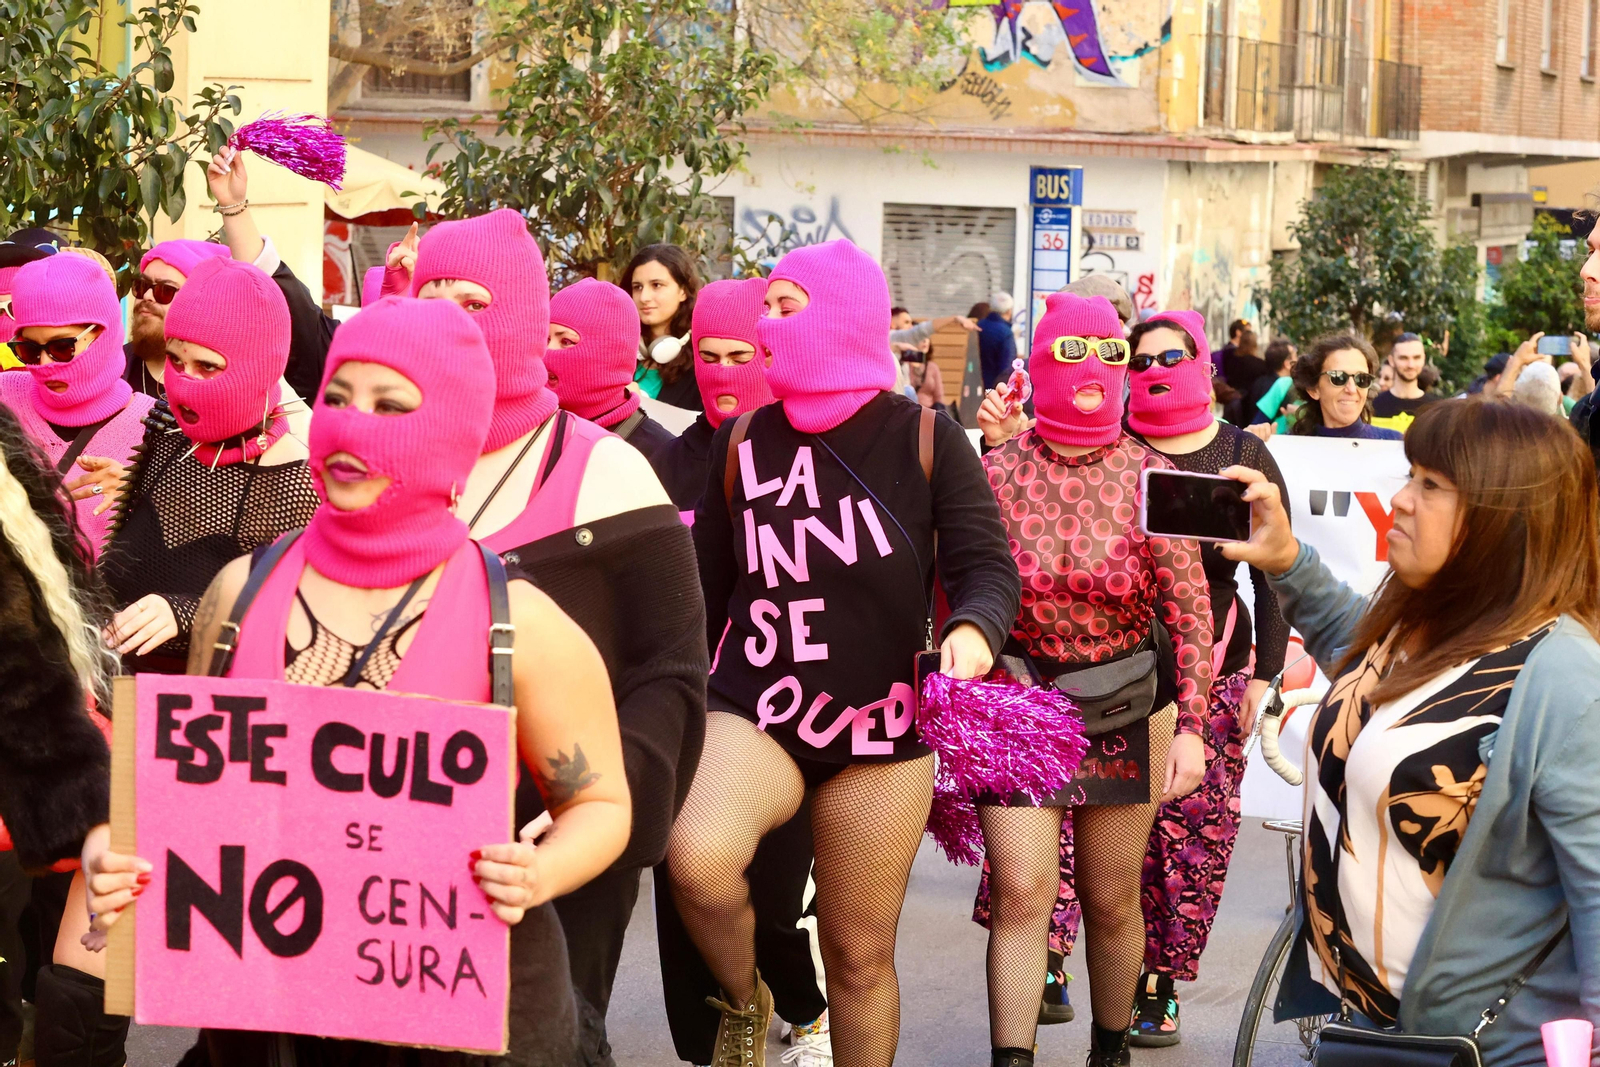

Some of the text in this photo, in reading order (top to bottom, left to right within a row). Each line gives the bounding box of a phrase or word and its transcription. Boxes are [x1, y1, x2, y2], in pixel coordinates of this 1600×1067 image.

[1036, 174, 1069, 199] BUS
[1042, 233, 1064, 250] 36
[737, 439, 821, 509] LA
[743, 494, 894, 589] INVI
[744, 598, 829, 668] SE
[756, 675, 917, 756] QUED
[155, 693, 489, 807] ESTE CULO
[345, 822, 384, 852] SE
[358, 875, 485, 931] CEN-
[355, 938, 487, 998] SURA
